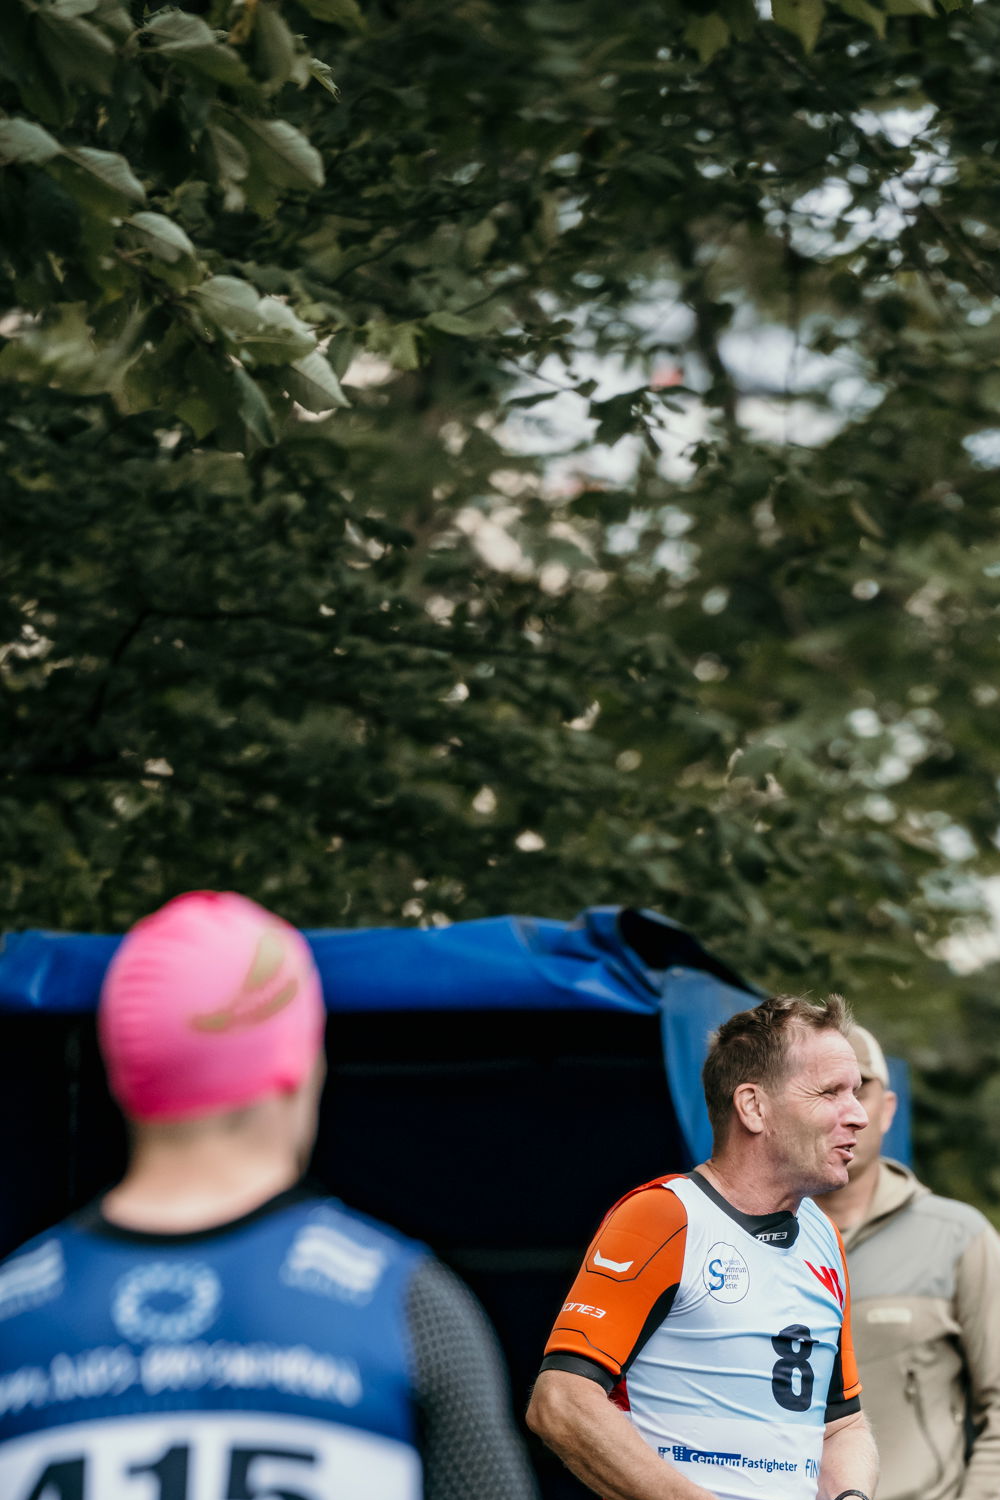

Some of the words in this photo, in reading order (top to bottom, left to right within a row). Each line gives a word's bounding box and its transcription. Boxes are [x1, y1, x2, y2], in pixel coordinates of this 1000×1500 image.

[562, 1302, 607, 1319] ONE3
[771, 1324, 819, 1412] 8
[690, 1452, 739, 1468] Centrum
[742, 1457, 798, 1473] Fastigheter
